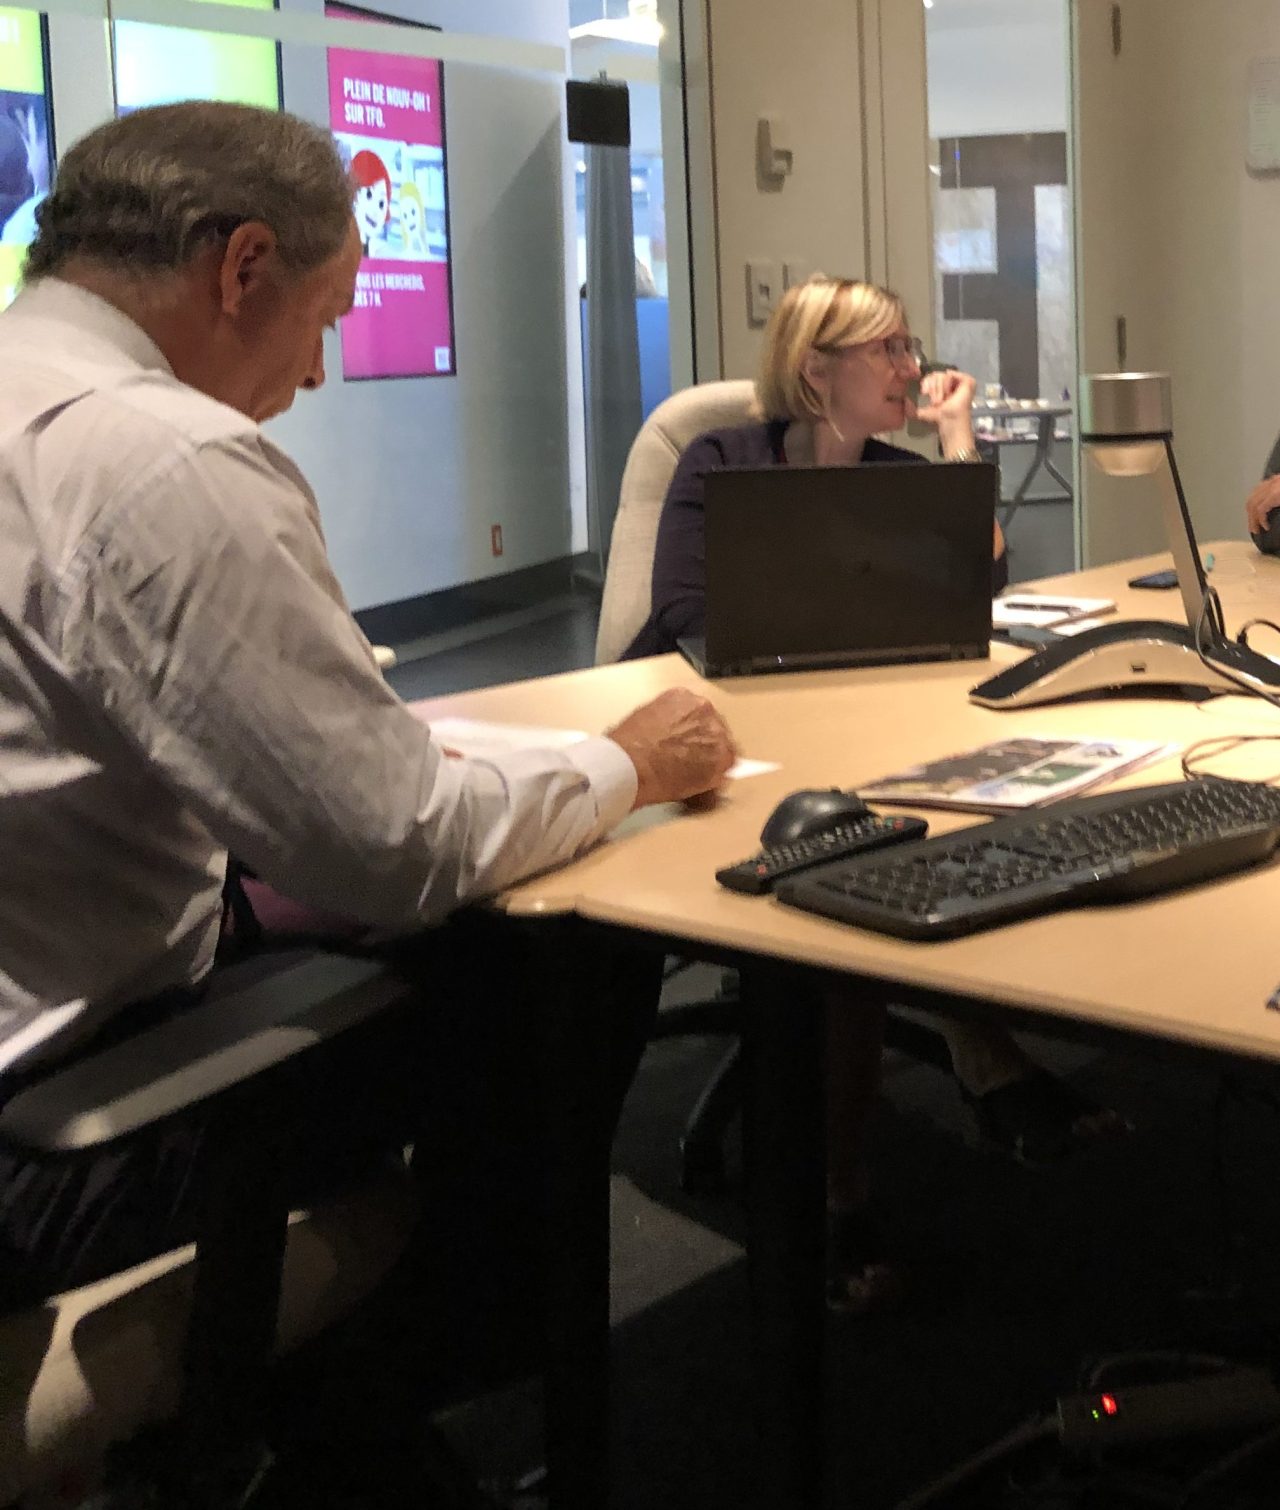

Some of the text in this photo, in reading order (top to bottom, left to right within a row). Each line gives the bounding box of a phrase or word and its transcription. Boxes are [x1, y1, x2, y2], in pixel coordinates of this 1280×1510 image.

[343, 77, 371, 102] PLEIN
[372, 82, 386, 105] DE
[344, 101, 386, 128] SUR TFO.
[356, 272, 371, 289] OUS
[371, 272, 385, 289] LES
